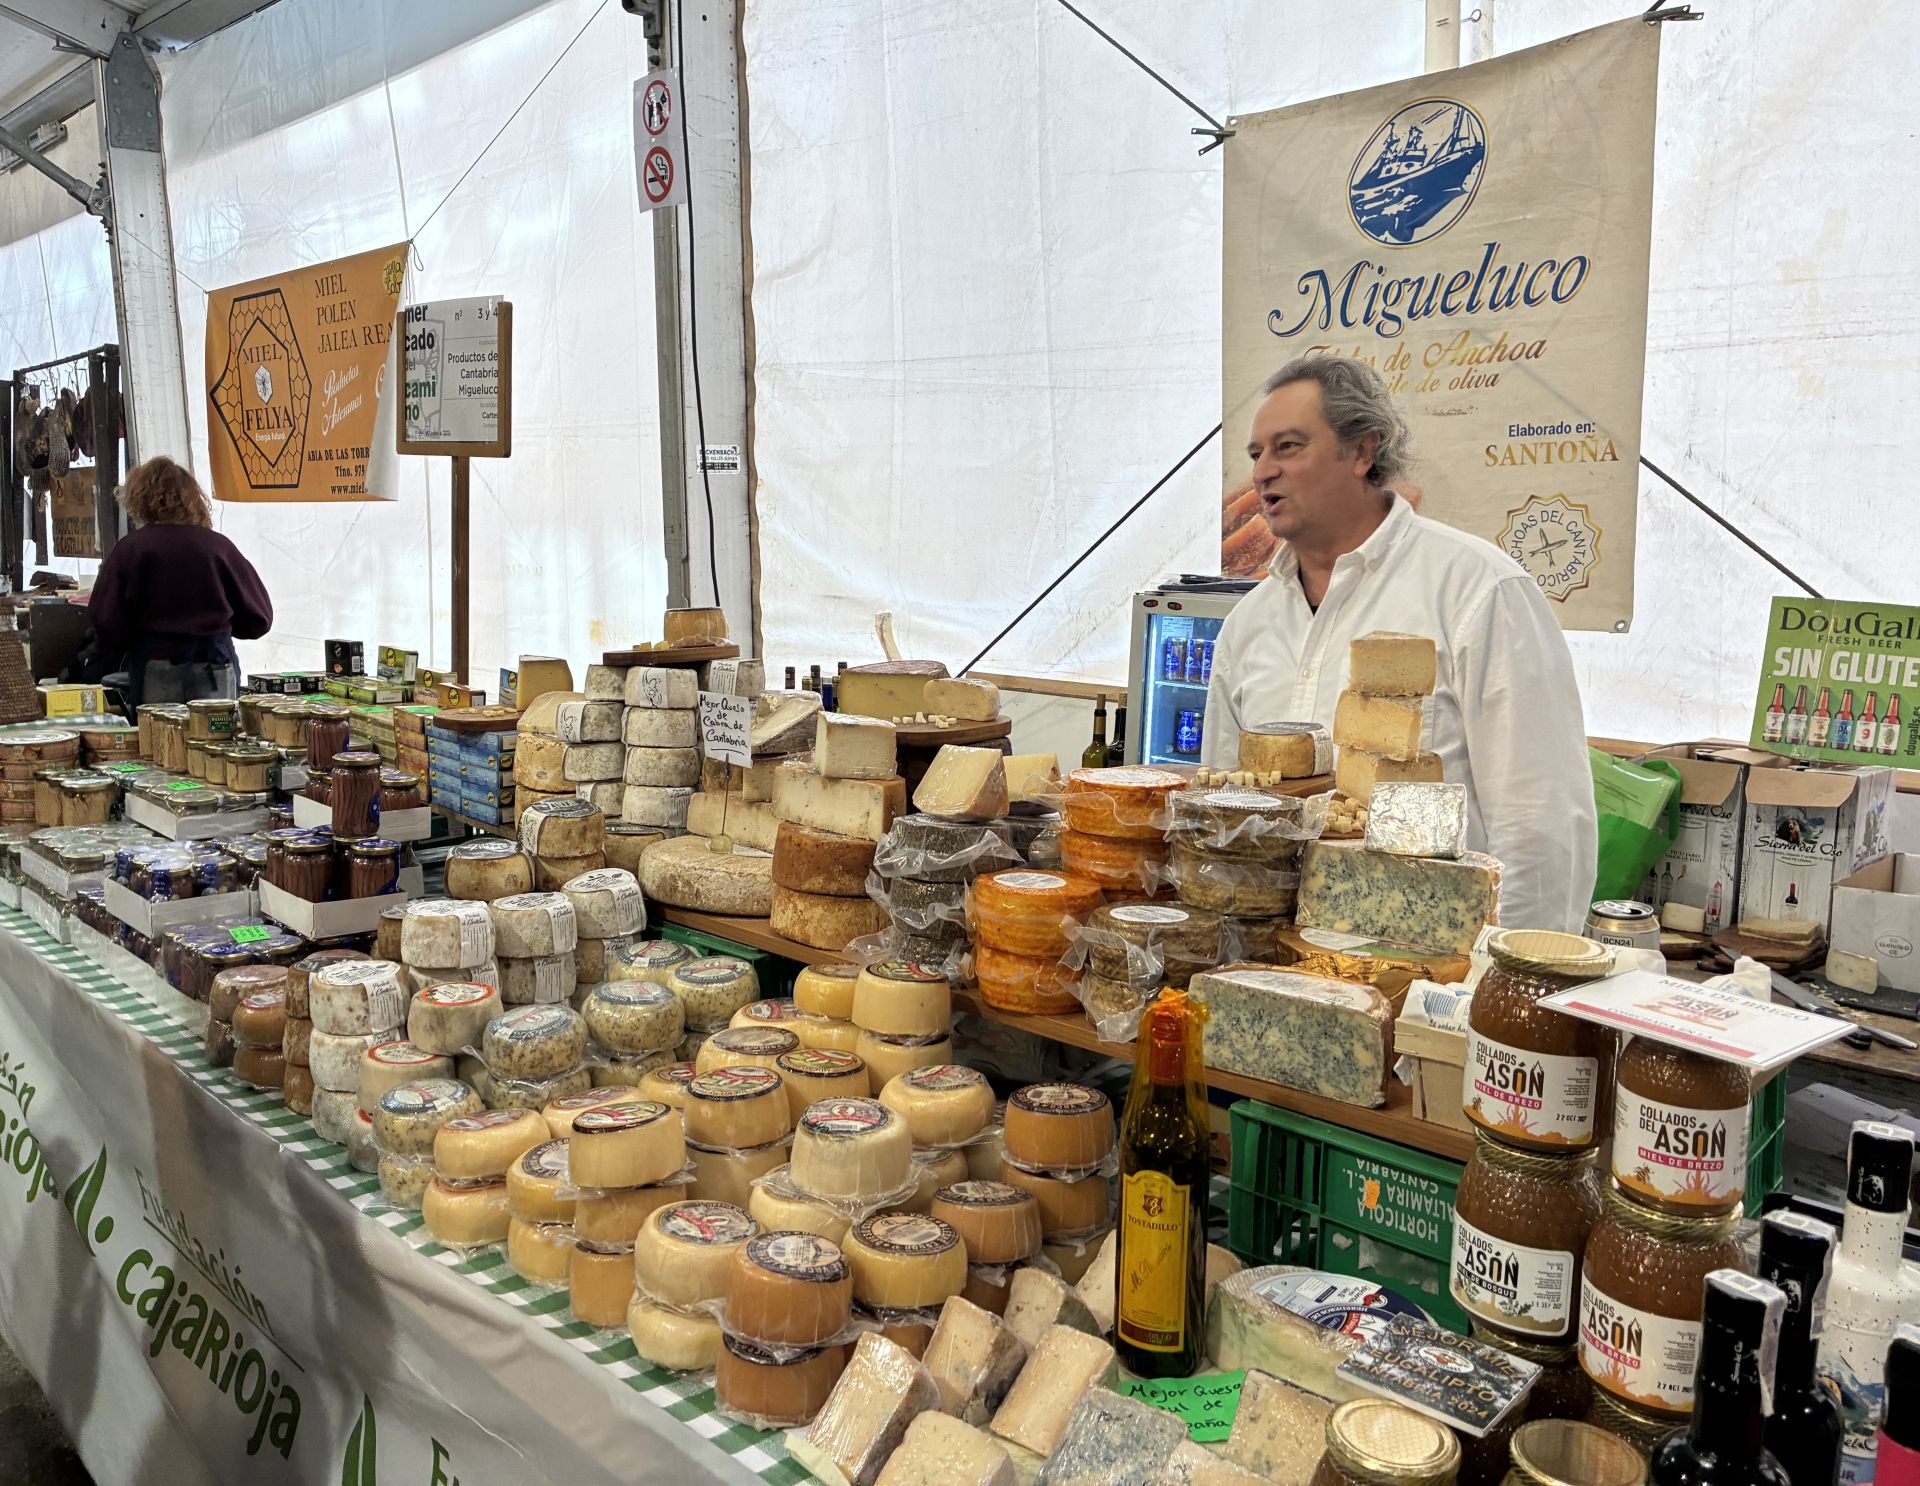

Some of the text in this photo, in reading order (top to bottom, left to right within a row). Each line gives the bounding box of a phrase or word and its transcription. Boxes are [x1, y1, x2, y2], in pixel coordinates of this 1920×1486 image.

[315, 274, 347, 298] MIEL
[1267, 242, 1592, 338] Migueluco
[317, 300, 356, 326] POLEN
[405, 305, 428, 324] mer
[478, 308, 483, 318] 3
[485, 310, 490, 320] y
[493, 307, 498, 317] 4
[318, 322, 393, 354] JALEA REA
[405, 328, 434, 351] cado
[244, 344, 282, 365] MIEL
[448, 351, 498, 363] Productos de
[1383, 342, 1411, 372] de
[1423, 330, 1548, 369] Anchoa
[461, 368, 498, 379] Cantabria
[1415, 371, 1441, 393] de
[1448, 366, 1500, 391] oliva
[405, 376, 436, 398] cami
[245, 406, 294, 431] FELYA
[1508, 421, 1596, 438] Elaborado en:
[308, 447, 370, 461] ABIA DE LAS TORR
[1484, 434, 1619, 467] SANTOÑA
[331, 483, 368, 494] www.miel
[1540, 510, 1565, 526] DEL
[1537, 520, 1586, 587] CANTÁBRICO
[1817, 634, 1902, 649] FRESH BEER
[1773, 647, 1920, 688] SIN GLUTE
[717, 710, 727, 720] de
[721, 698, 745, 712] Queso
[703, 715, 746, 732] Cabra de
[705, 729, 748, 748] Cantabria
[1710, 806, 1732, 819] Oso
[1754, 836, 1797, 851] Sierra
[1797, 843, 1816, 853] del
[1820, 843, 1843, 857] Oso
[1603, 937, 1631, 946] BCN24
[1658, 979, 1707, 995] MIEL
[1710, 992, 1740, 1002] DE
[1742, 999, 1810, 1022] BREZO
[1476, 1041, 1517, 1066] COLLADOS
[1476, 1052, 1488, 1068] DEL
[1485, 1060, 1545, 1099] ASÓN
[1475, 1081, 1540, 1109] MIEL DE BREZO
[1640, 1104, 1697, 1129] COLLADOS
[1640, 1117, 1658, 1134] DEL
[1653, 1118, 1726, 1158] ASÓN
[1640, 1148, 1721, 1170] MIEL DE BREZO
[1357, 1158, 1438, 1193] CANTABRIA
[1387, 1183, 1454, 1222] ALTAMIRA
[1127, 1214, 1179, 1231] TOSTADILLO
[1458, 1225, 1494, 1254] COLLADOS
[1458, 1236, 1468, 1252] DEL
[134, 1165, 276, 1338] Fundación
[1464, 1245, 1519, 1288] ASÓN
[1471, 1275, 1480, 1284] DE
[1482, 1280, 1515, 1299] BOSQUE
[1583, 1284, 1615, 1318] COLLADOS
[1583, 1295, 1591, 1314] DEL
[1588, 1306, 1643, 1358] ASÓN
[1390, 1326, 1524, 1382] MEJOR MIEL
[1595, 1339, 1605, 1352] DE
[1607, 1347, 1639, 1368] BREZO
[1129, 1383, 1242, 1403] Mejor Queso
[1350, 1359, 1489, 1419] CANTABRIA 2024
[1203, 1400, 1223, 1411] de
